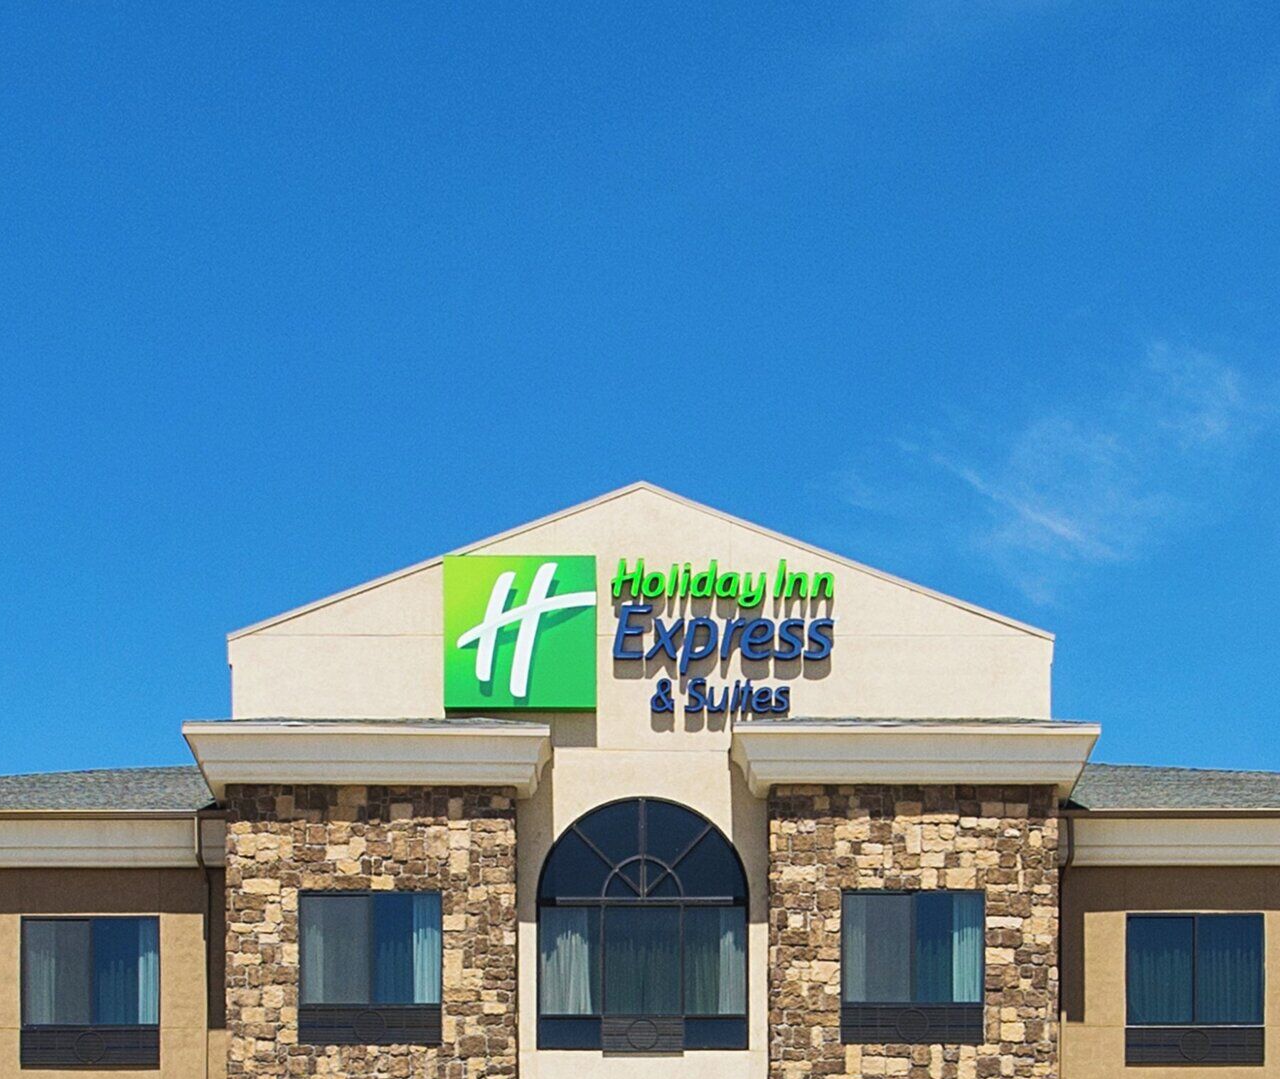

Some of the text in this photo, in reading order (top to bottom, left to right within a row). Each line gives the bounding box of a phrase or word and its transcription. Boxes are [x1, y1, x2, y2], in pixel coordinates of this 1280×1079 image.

[611, 558, 835, 608] Holiday Inn
[613, 604, 834, 676] Express
[651, 677, 791, 713] & Suites
